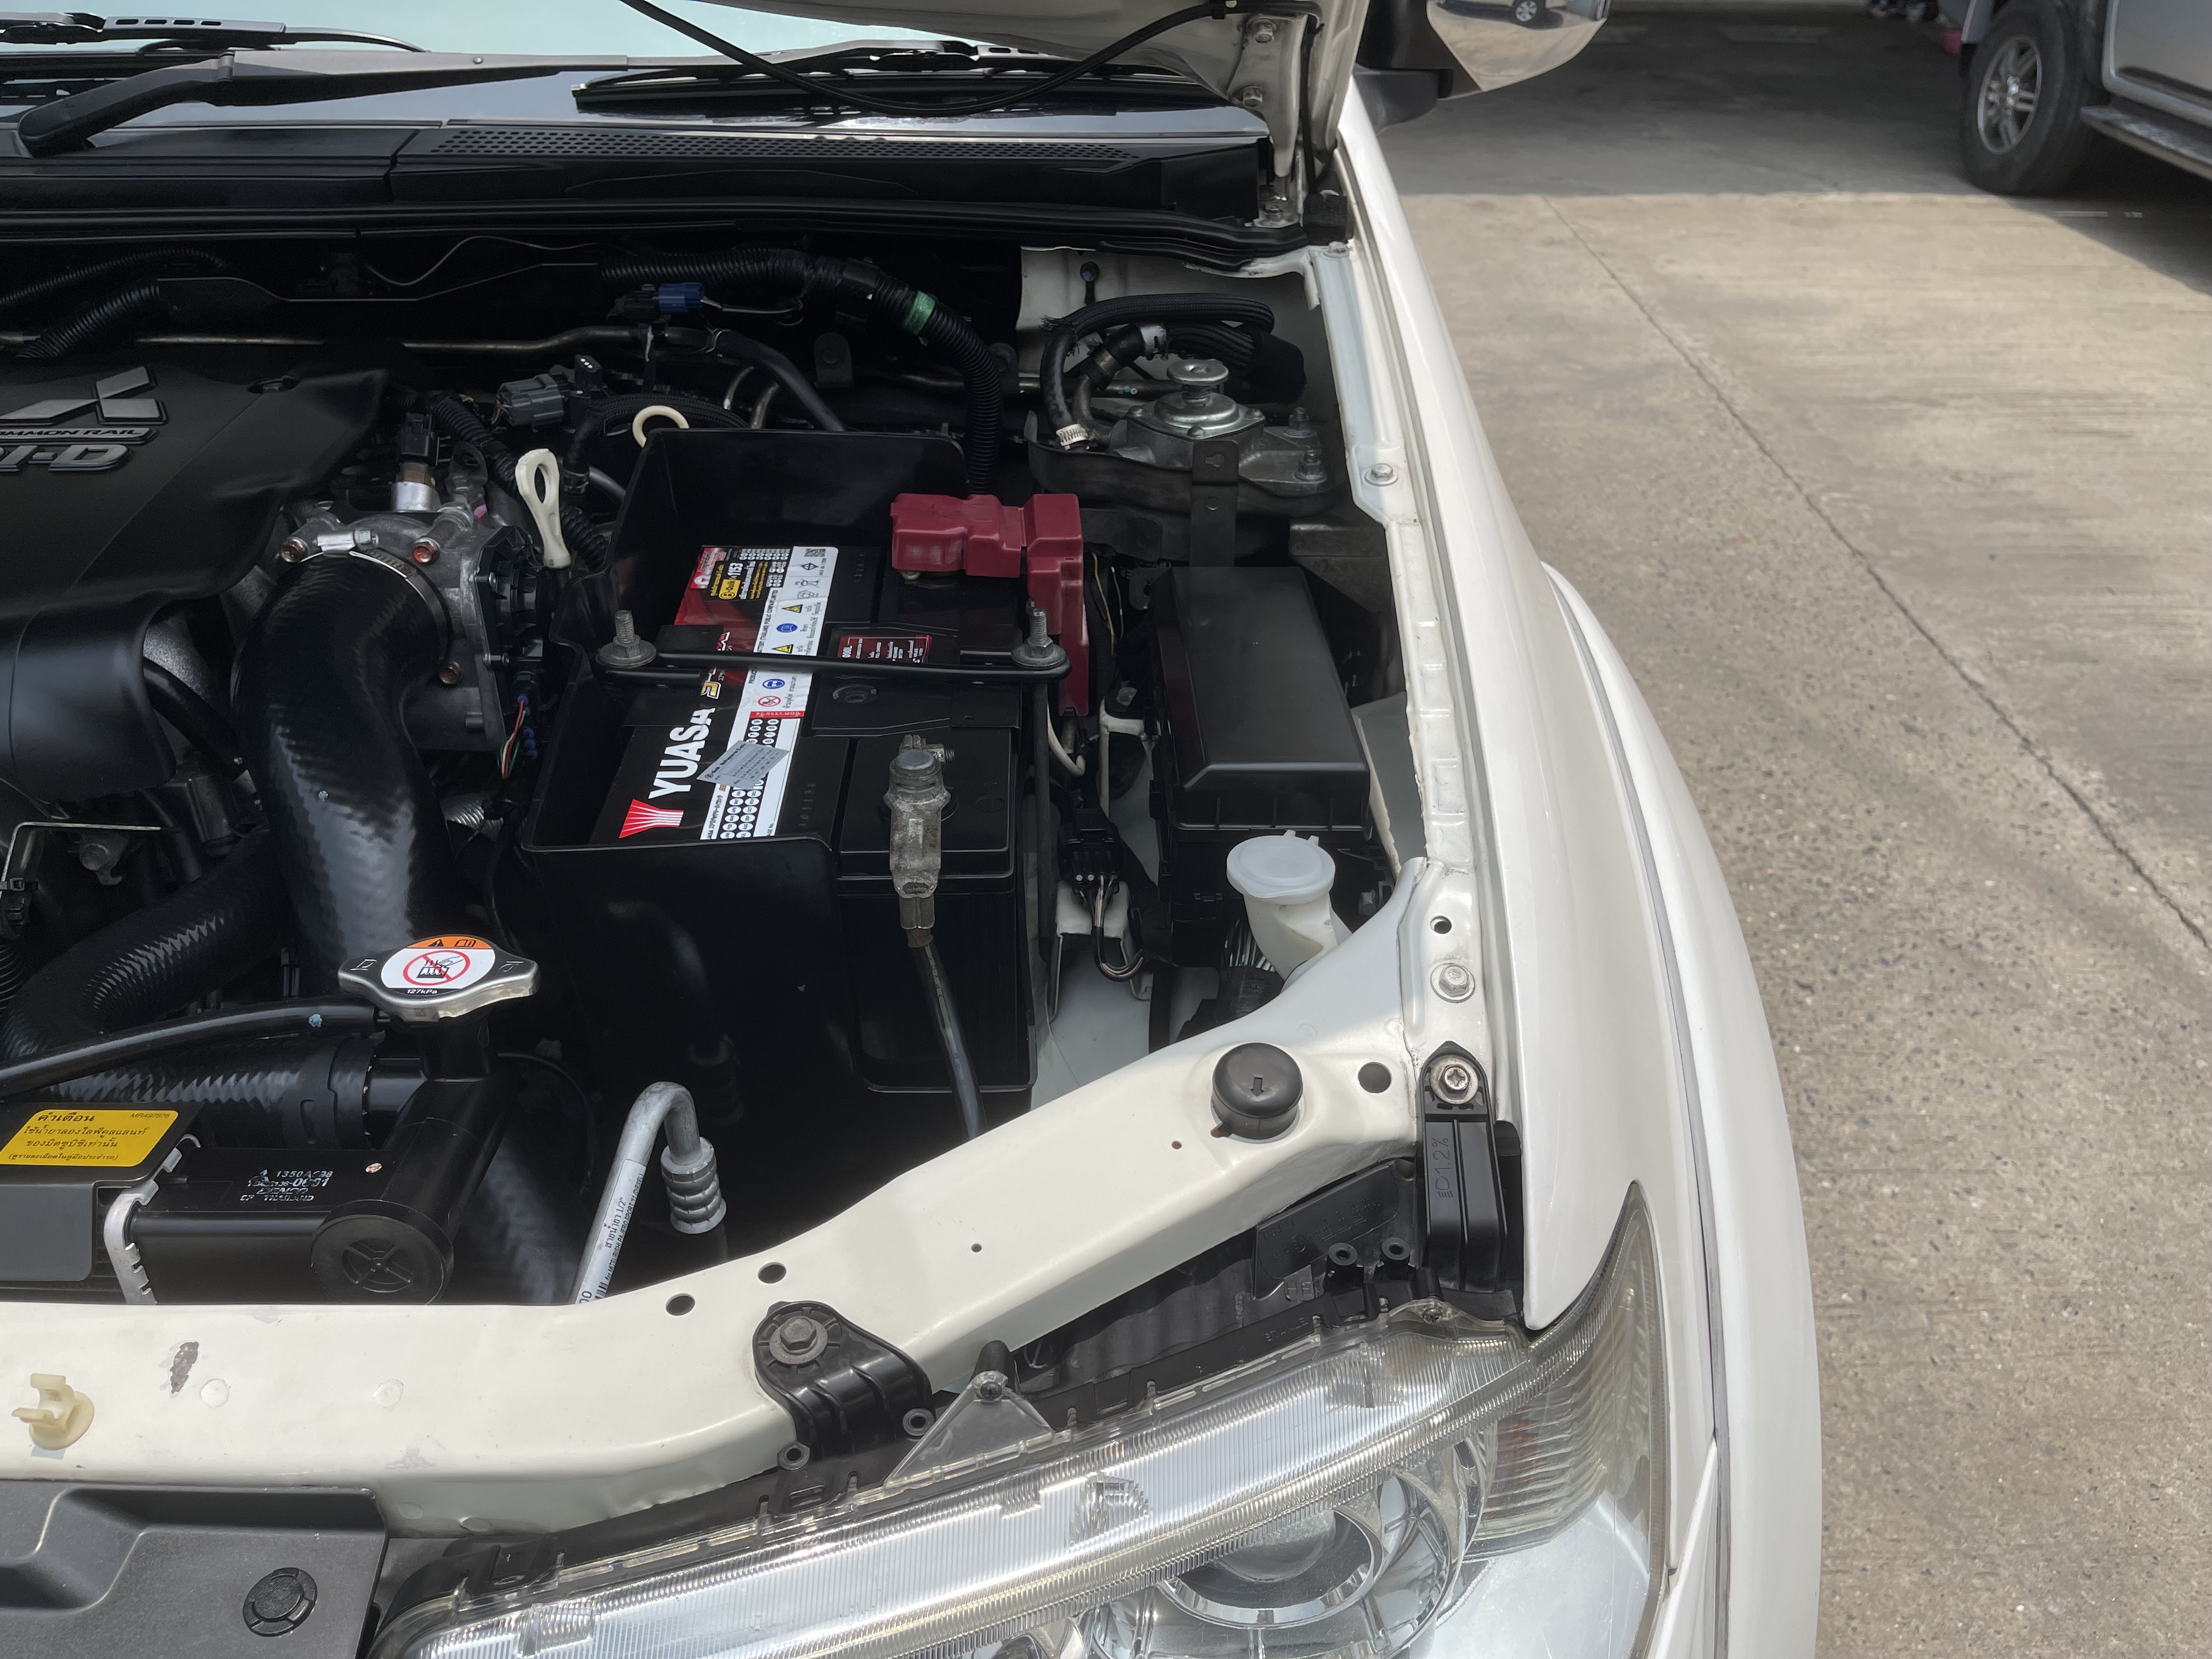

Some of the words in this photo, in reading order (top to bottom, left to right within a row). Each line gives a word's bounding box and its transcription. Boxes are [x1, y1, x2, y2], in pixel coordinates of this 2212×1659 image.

[0, 444, 128, 471] I-D
[728, 562, 743, 577] 1153
[649, 707, 716, 799] YUASA
[38, 1112, 95, 1122] คำเตือน
[1431, 1137, 1451, 1175] 1.2%
[608, 1242, 620, 1272] MITSUBISHI
[618, 1220, 629, 1243] PAJERO
[625, 1201, 635, 1221] SPORT
